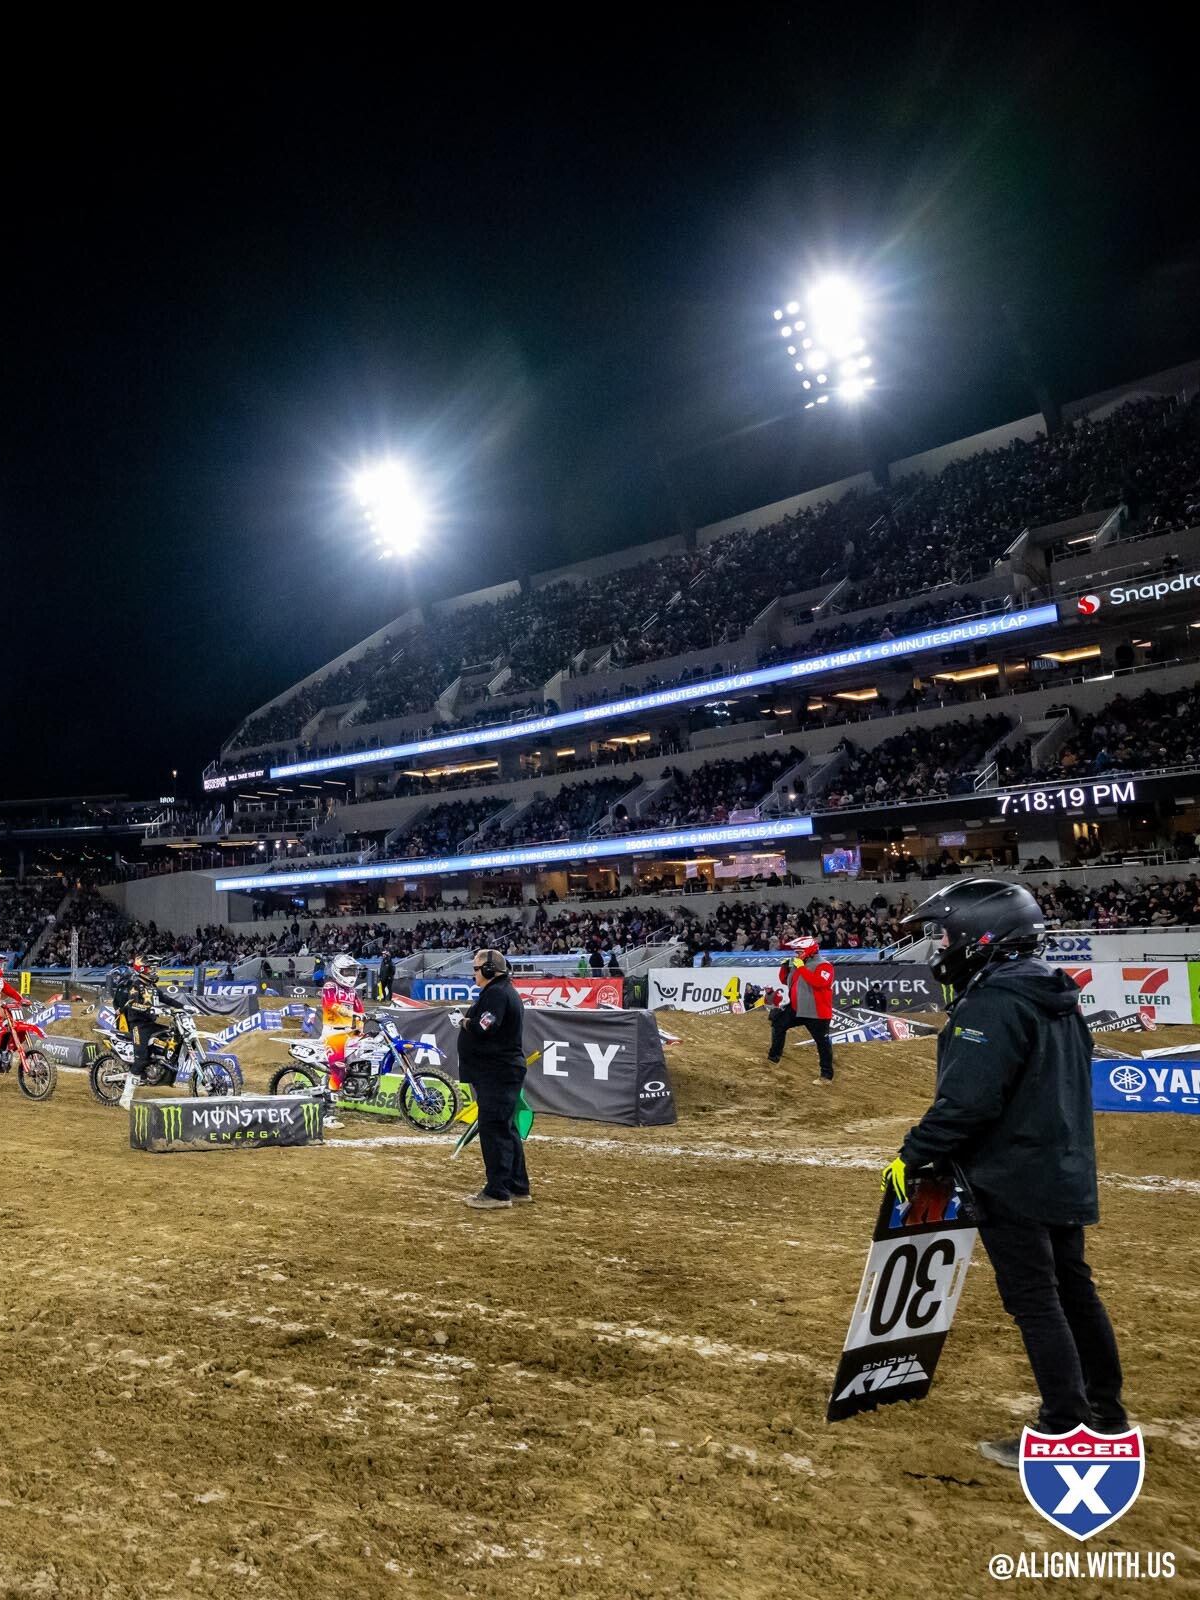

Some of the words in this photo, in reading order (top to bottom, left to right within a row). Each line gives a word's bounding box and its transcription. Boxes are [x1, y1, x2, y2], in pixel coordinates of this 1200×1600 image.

[791, 658, 828, 676] 250SX
[830, 651, 862, 667] HEAT
[864, 649, 871, 660] 1
[880, 645, 889, 656] 6
[892, 623, 988, 654] MINUTES/PLUS
[999, 615, 1028, 630] LAP
[583, 705, 612, 720] 250SX
[612, 700, 636, 714] HEAT
[656, 681, 724, 704] MINUTES/PLUS
[733, 675, 752, 688] LAP
[442, 735, 463, 748] HEAT
[997, 787, 1084, 814] 7:18:19
[1093, 782, 1135, 803] PM
[625, 838, 652, 850] 250SX
[654, 836, 676, 847] HEAT
[698, 827, 764, 842] MINUTES/PLUS
[774, 824, 793, 834] LAP
[492, 854, 510, 864] HEAT
[1046, 938, 1092, 952] OX
[1046, 954, 1092, 962] BUSINESS
[204, 985, 258, 996] LKEN
[723, 976, 742, 1003] 4
[1122, 968, 1169, 1020] 7
[10, 1009, 24, 1020] 111
[1090, 1016, 1137, 1033] MOUNTAIN
[639, 1090, 671, 1099] OAKLEY
[192, 1106, 294, 1129] MONSTER
[210, 1130, 280, 1141] ENERGY
[870, 1238, 955, 1336] 30
[863, 1353, 918, 1371] RACING
[835, 1360, 929, 1401] FLY
